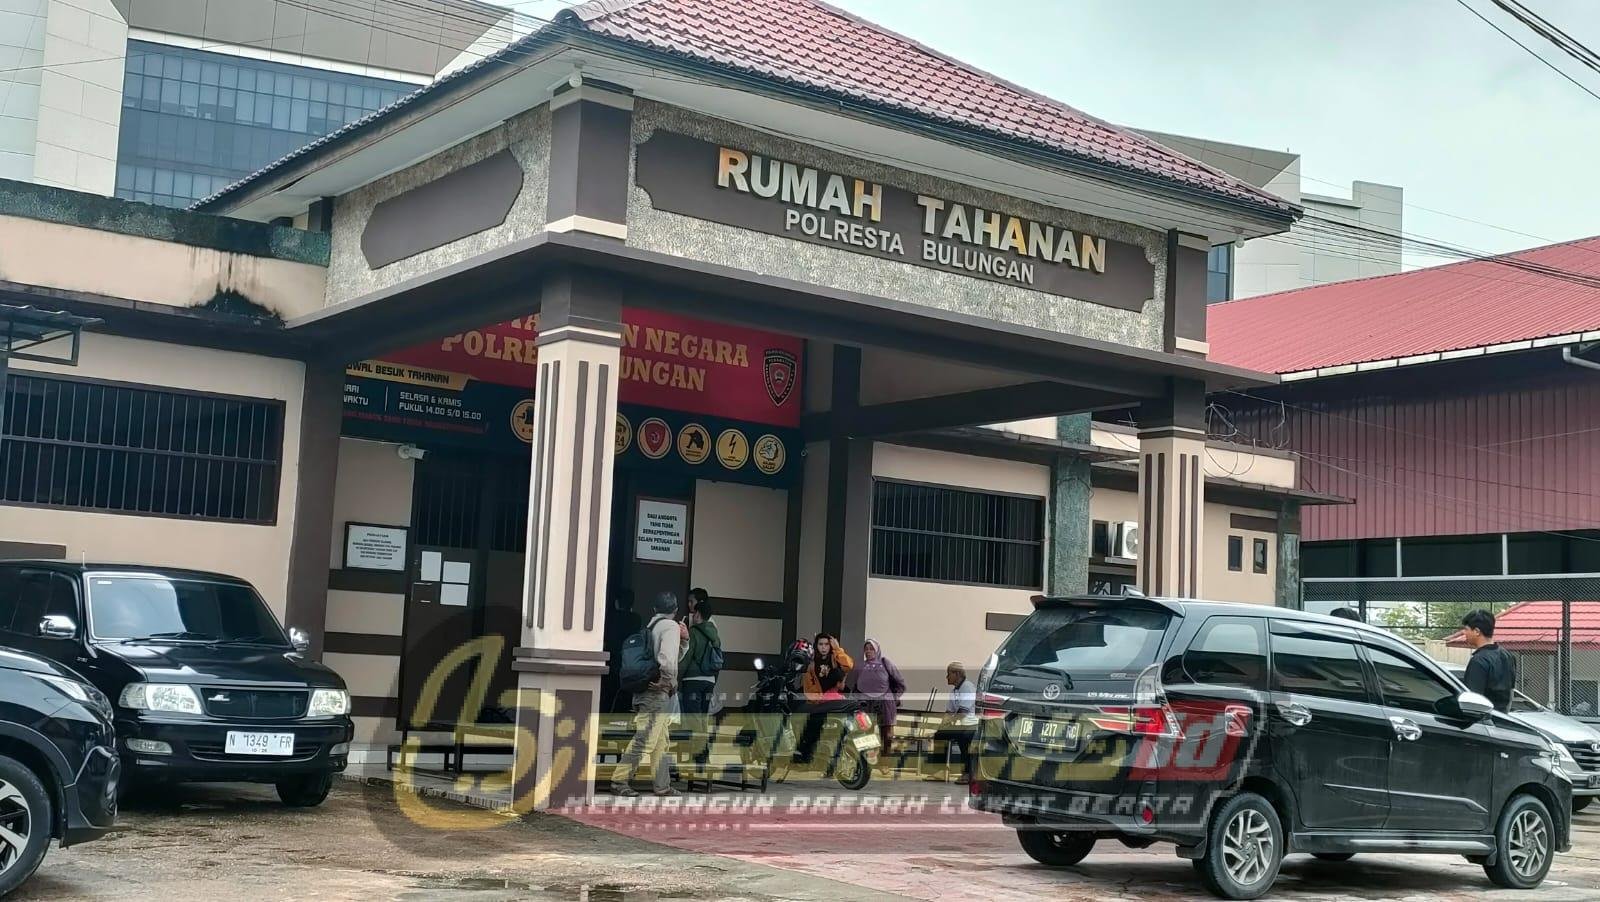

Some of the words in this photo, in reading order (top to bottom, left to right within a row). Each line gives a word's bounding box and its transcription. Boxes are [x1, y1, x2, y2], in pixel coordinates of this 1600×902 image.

[717, 147, 883, 222] RUMAH
[917, 194, 1107, 274] TAHANAN
[785, 209, 905, 256] POLRESTA
[922, 242, 1035, 285] BULUNGAN
[645, 327, 749, 368] NEGARA
[376, 365, 405, 378] BESUK
[408, 370, 450, 384] TAHANAN
[399, 391, 429, 403] SELASA
[430, 396, 436, 404] &
[438, 397, 462, 407] KAMIS
[398, 402, 424, 413] PUKUL
[425, 405, 445, 416] 14.00
[447, 408, 461, 418] S/D
[462, 410, 482, 420] 15.00
[229, 734, 236, 747] N
[280, 735, 292, 748] FR
